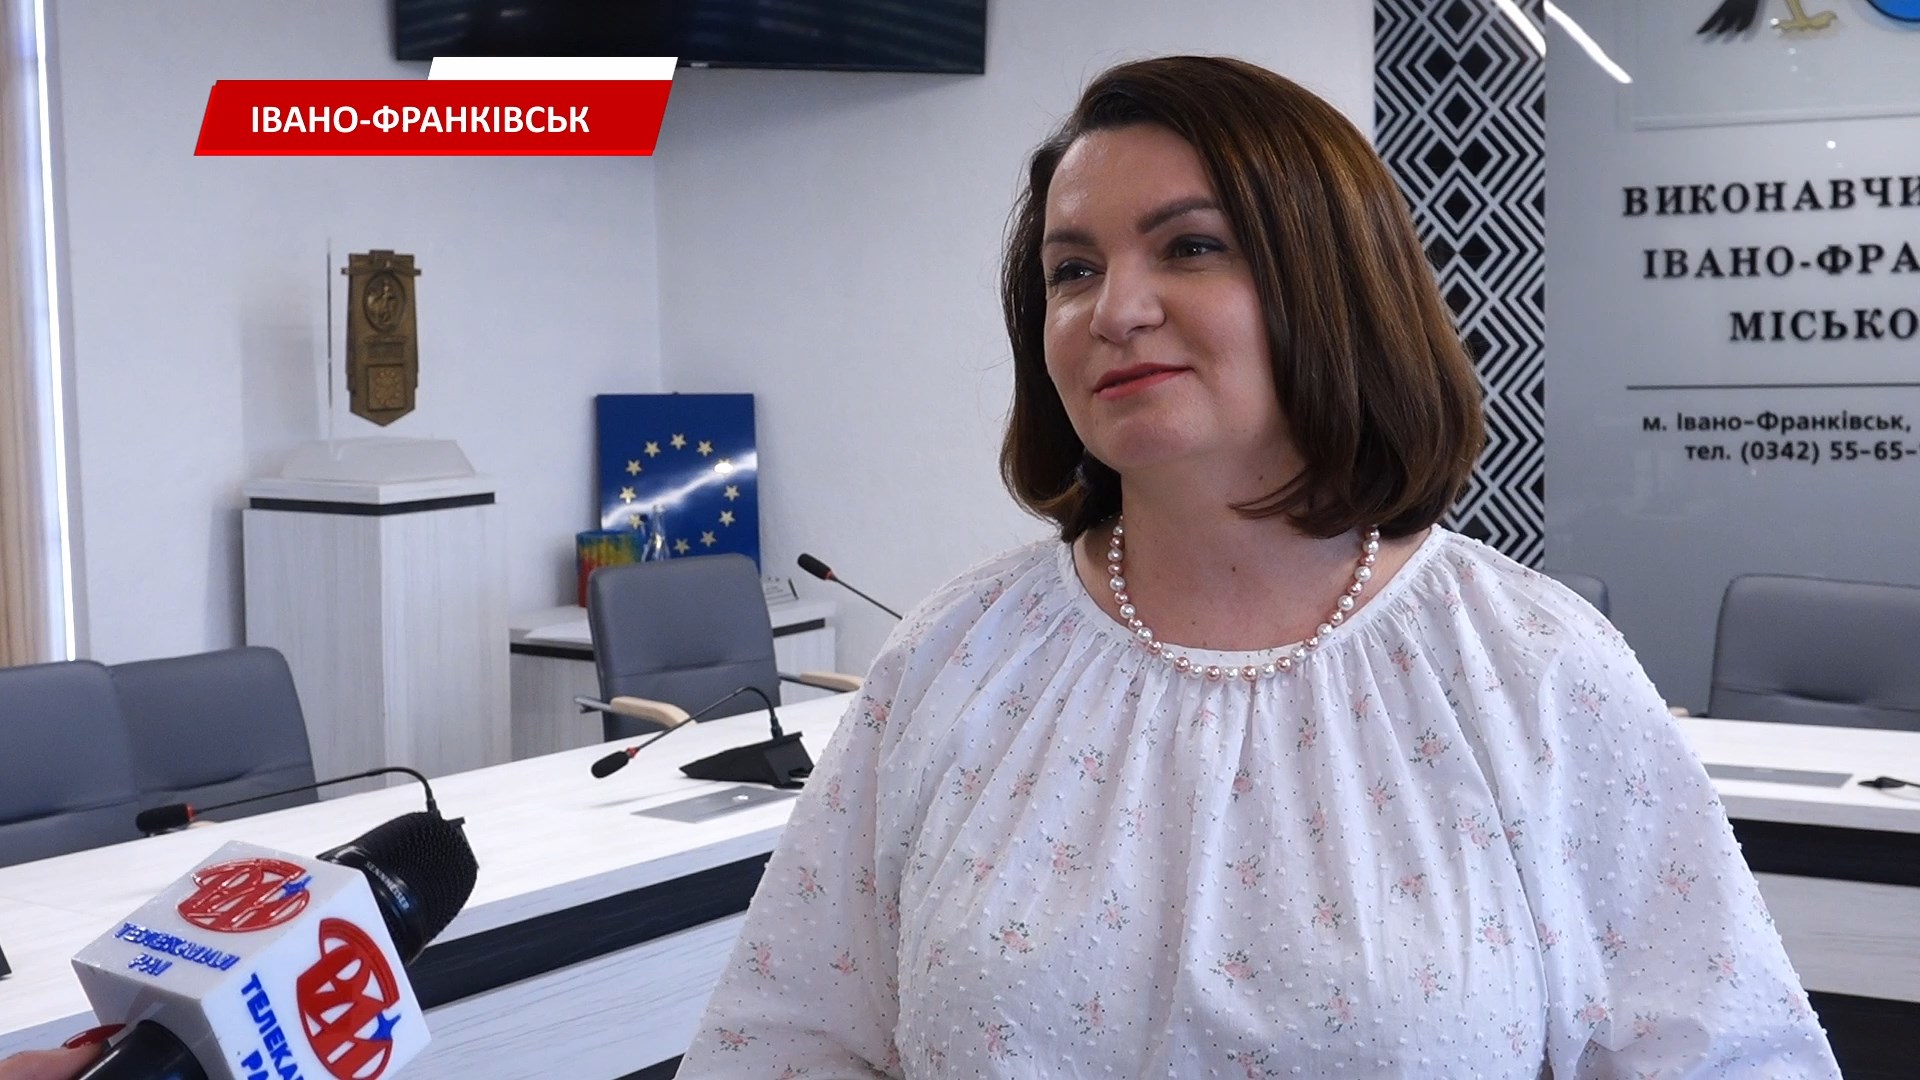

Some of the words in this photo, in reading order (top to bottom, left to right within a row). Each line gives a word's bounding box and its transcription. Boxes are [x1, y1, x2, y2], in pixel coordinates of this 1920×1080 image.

[1643, 241, 1920, 279] ІВАНО-ФРА
[1729, 308, 1919, 341] МІСЬКО
[1642, 415, 1668, 431] м.
[1677, 410, 1912, 435] Івано-Франківськ,
[1685, 444, 1731, 460] тел.
[1741, 441, 1820, 464] (0342)
[1830, 441, 1920, 460] 55-65-
[241, 973, 304, 1080] ТЕЛЕКА
